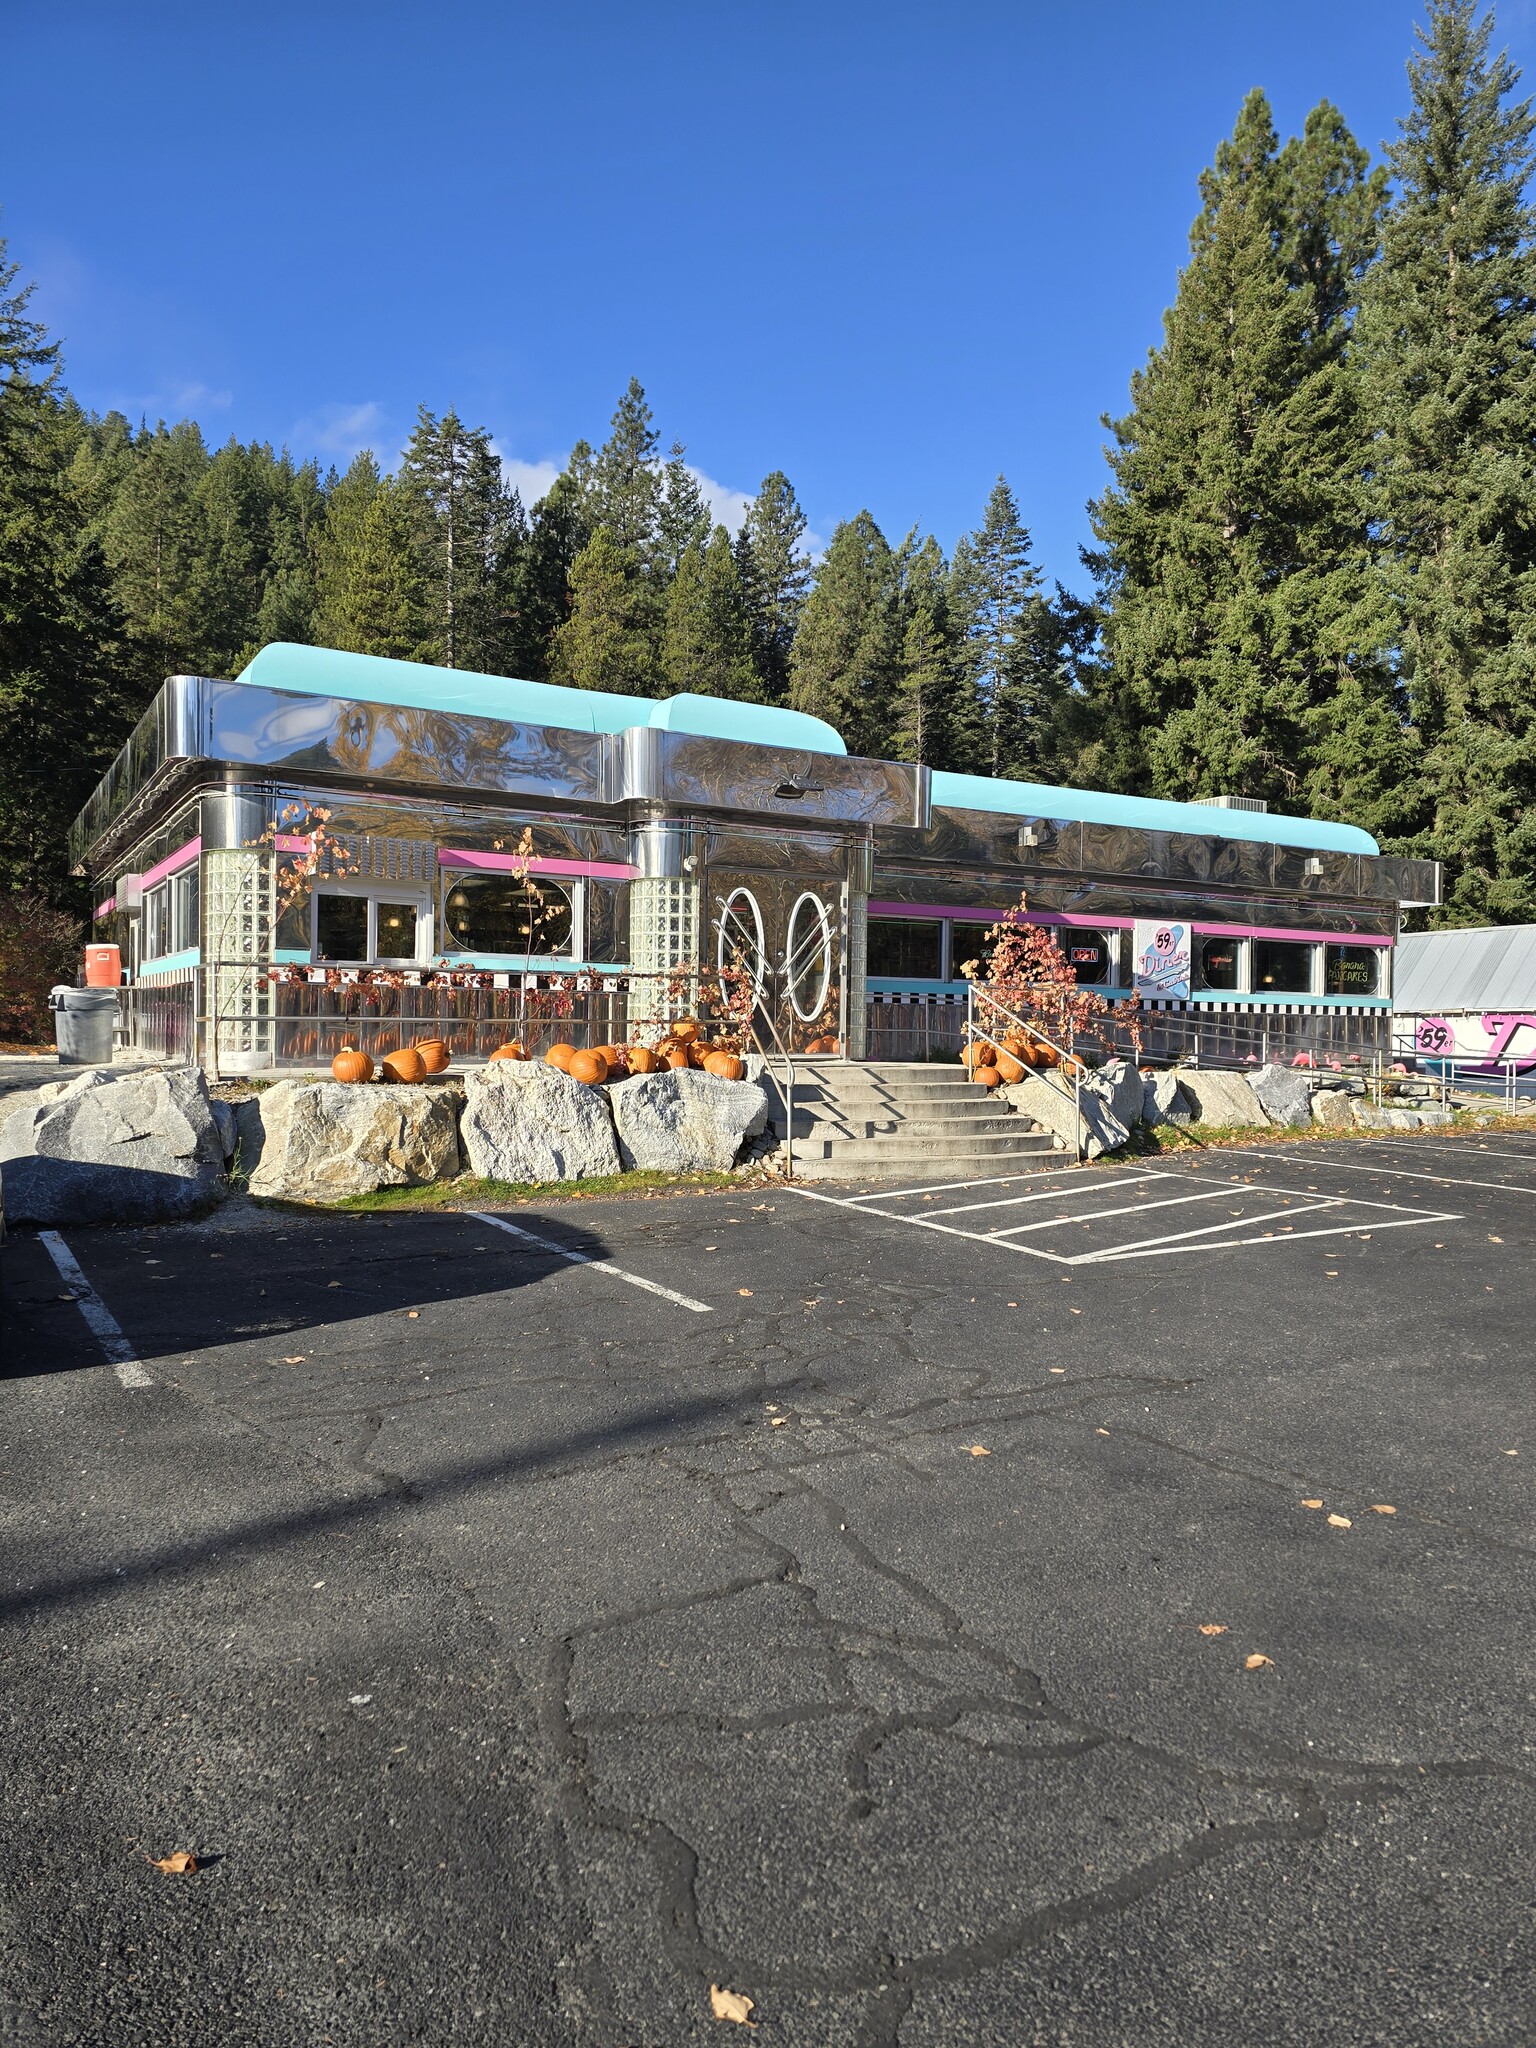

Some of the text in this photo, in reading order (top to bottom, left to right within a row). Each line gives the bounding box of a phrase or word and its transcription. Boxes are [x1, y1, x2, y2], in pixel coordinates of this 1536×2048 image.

[1138, 950, 1190, 978] Diner
[1333, 959, 1365, 971] Banana
[1328, 970, 1368, 982] PANCAKES
